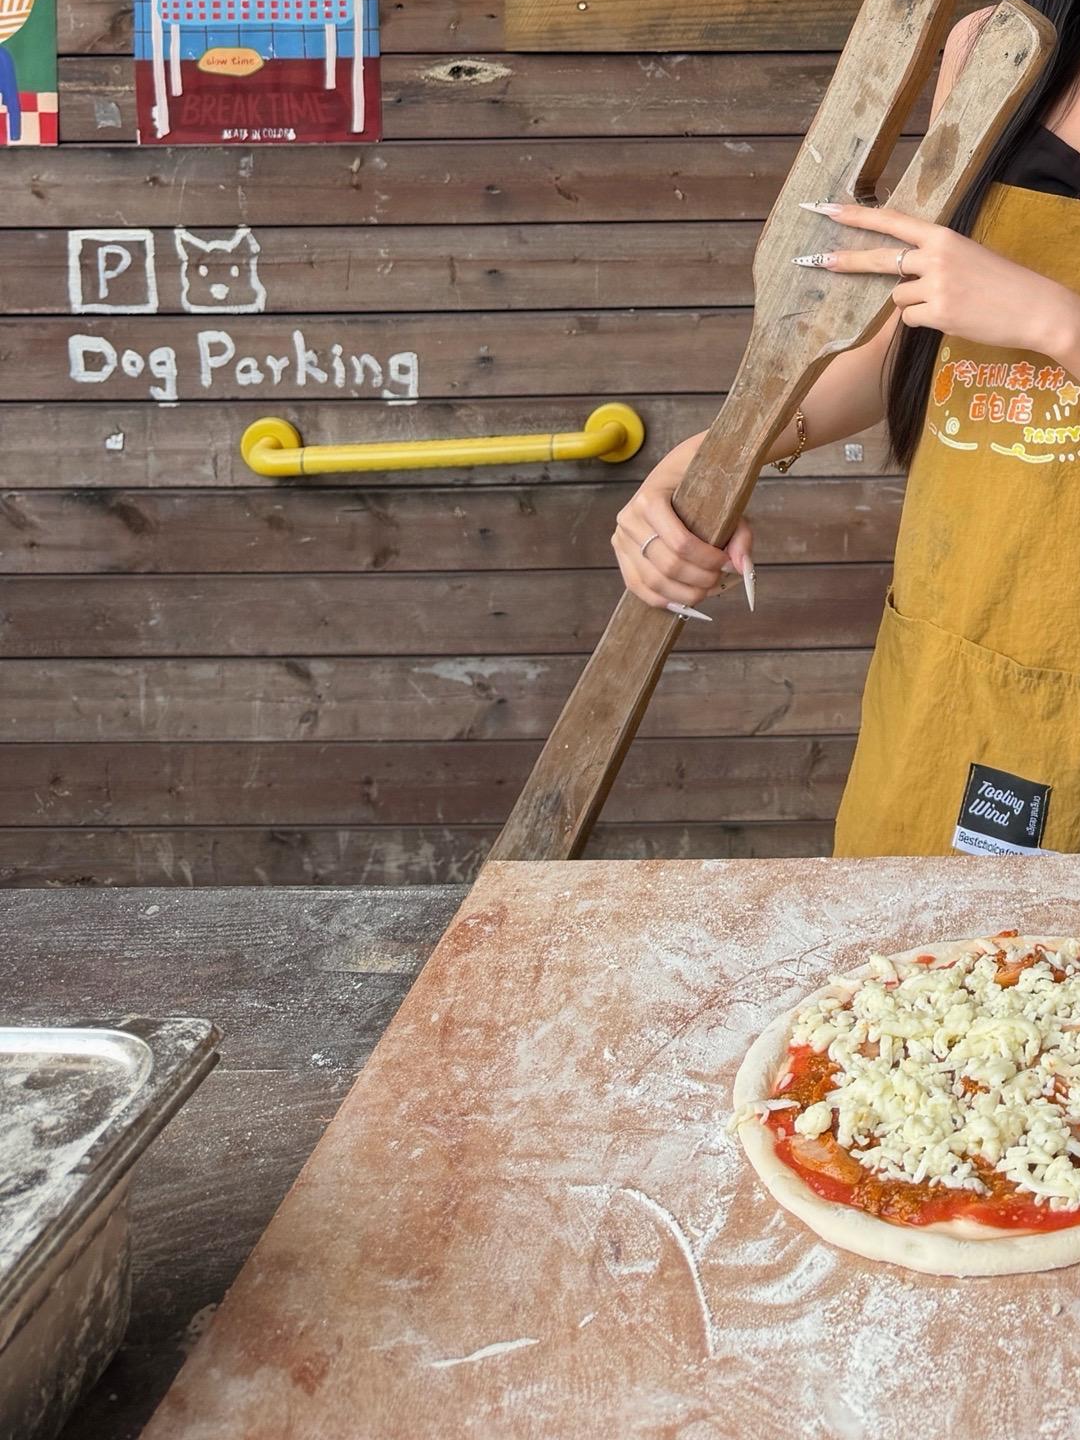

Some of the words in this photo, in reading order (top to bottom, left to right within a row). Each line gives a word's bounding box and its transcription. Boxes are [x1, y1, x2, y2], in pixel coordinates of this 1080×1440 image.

[232, 56, 255, 66] time
[182, 93, 264, 125] BREAK
[266, 93, 336, 124] TIME
[98, 245, 132, 299] P
[68, 334, 178, 406] Dog
[198, 330, 418, 405] Parking
[969, 392, 1033, 424] 面包店
[968, 798, 1010, 826] Wind
[977, 780, 1025, 815] Tooling
